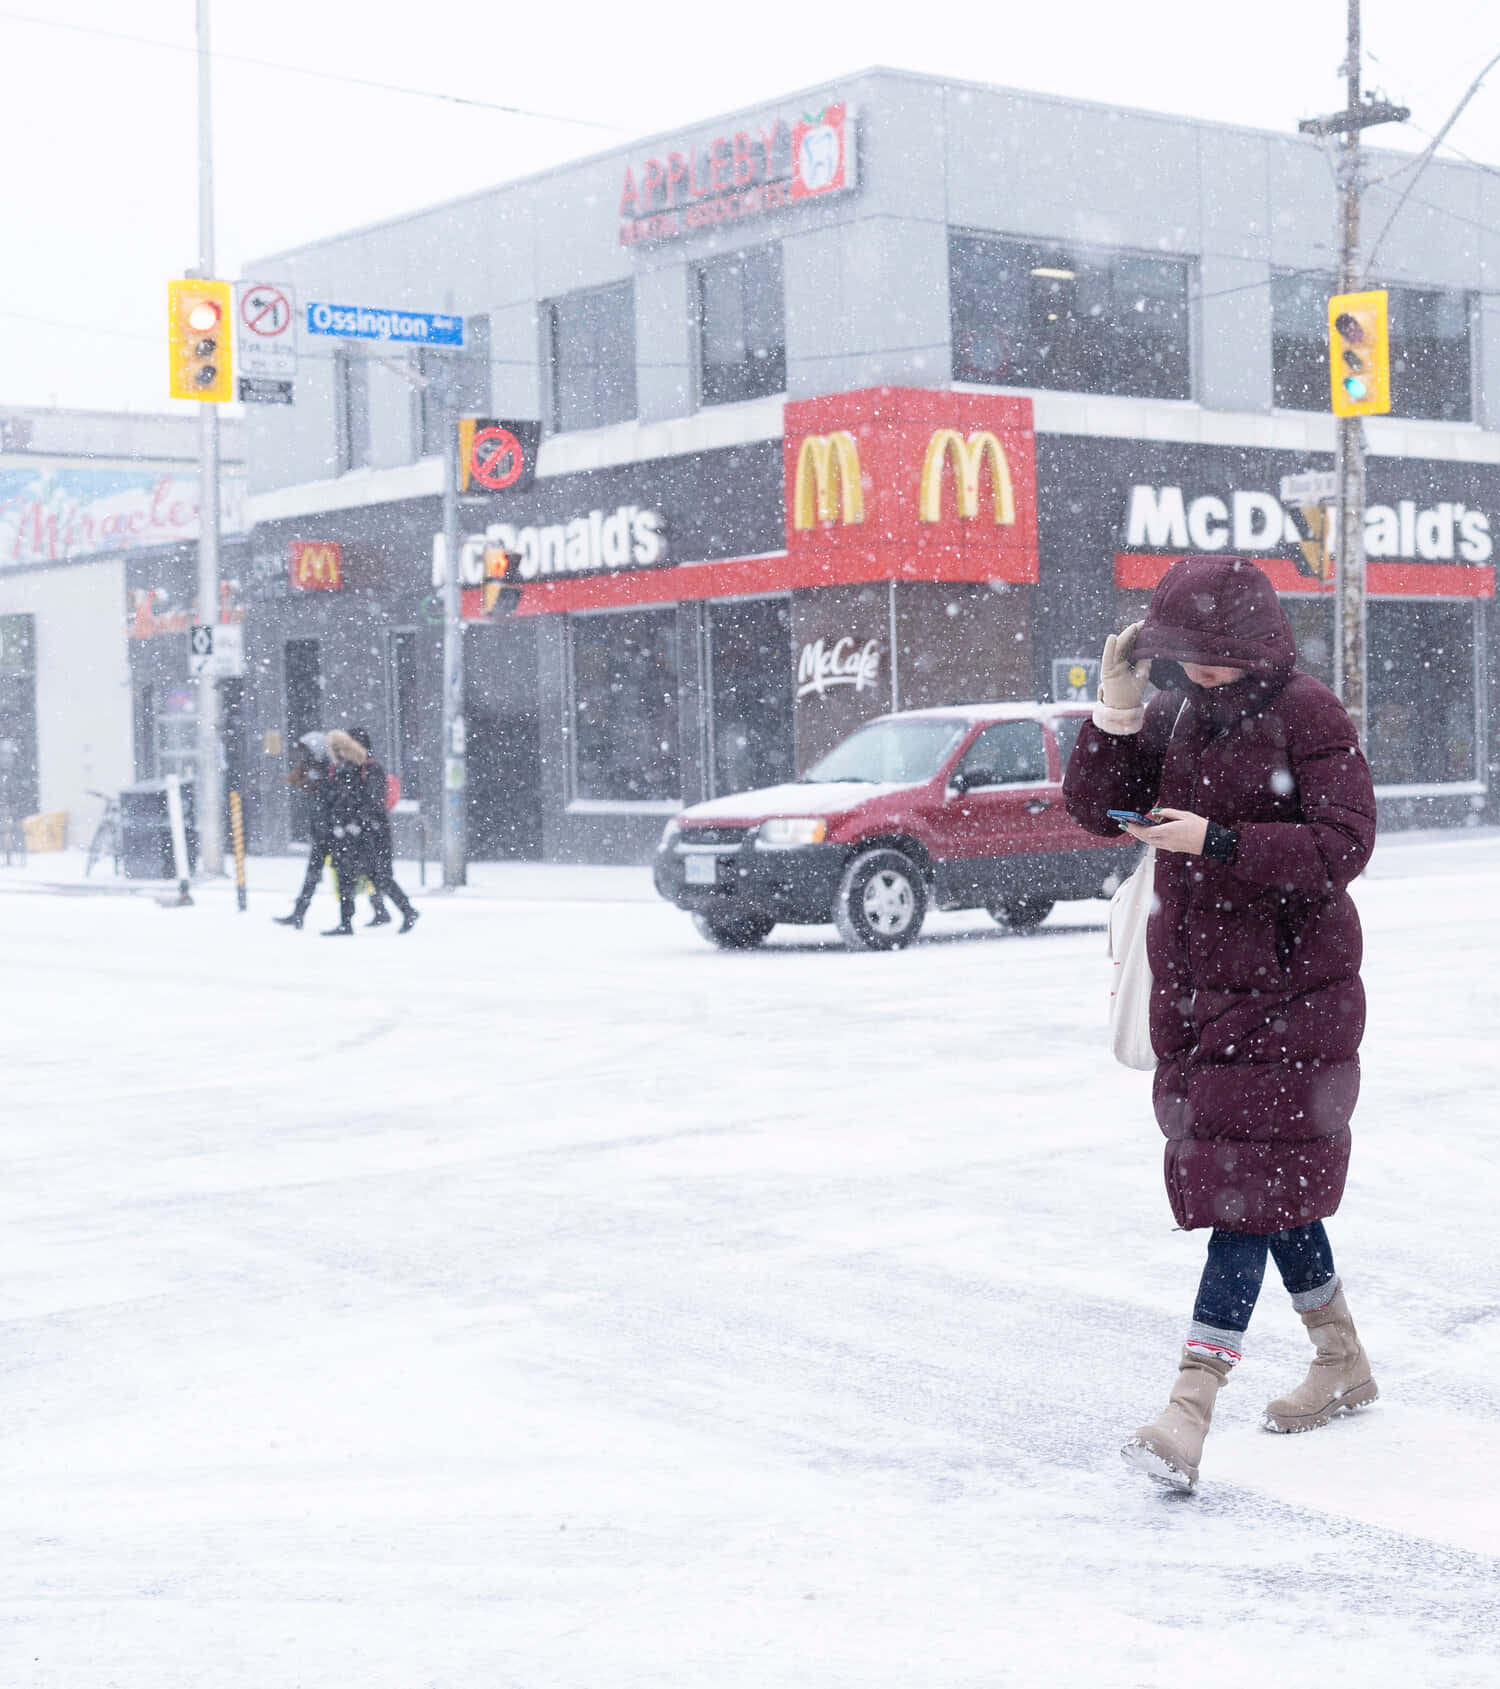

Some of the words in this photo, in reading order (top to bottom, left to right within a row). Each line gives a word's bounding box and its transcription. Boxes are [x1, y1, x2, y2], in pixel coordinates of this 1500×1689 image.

[619, 118, 782, 217] APPLEBY
[312, 305, 429, 341] Ossington
[1126, 484, 1494, 562] McDald's
